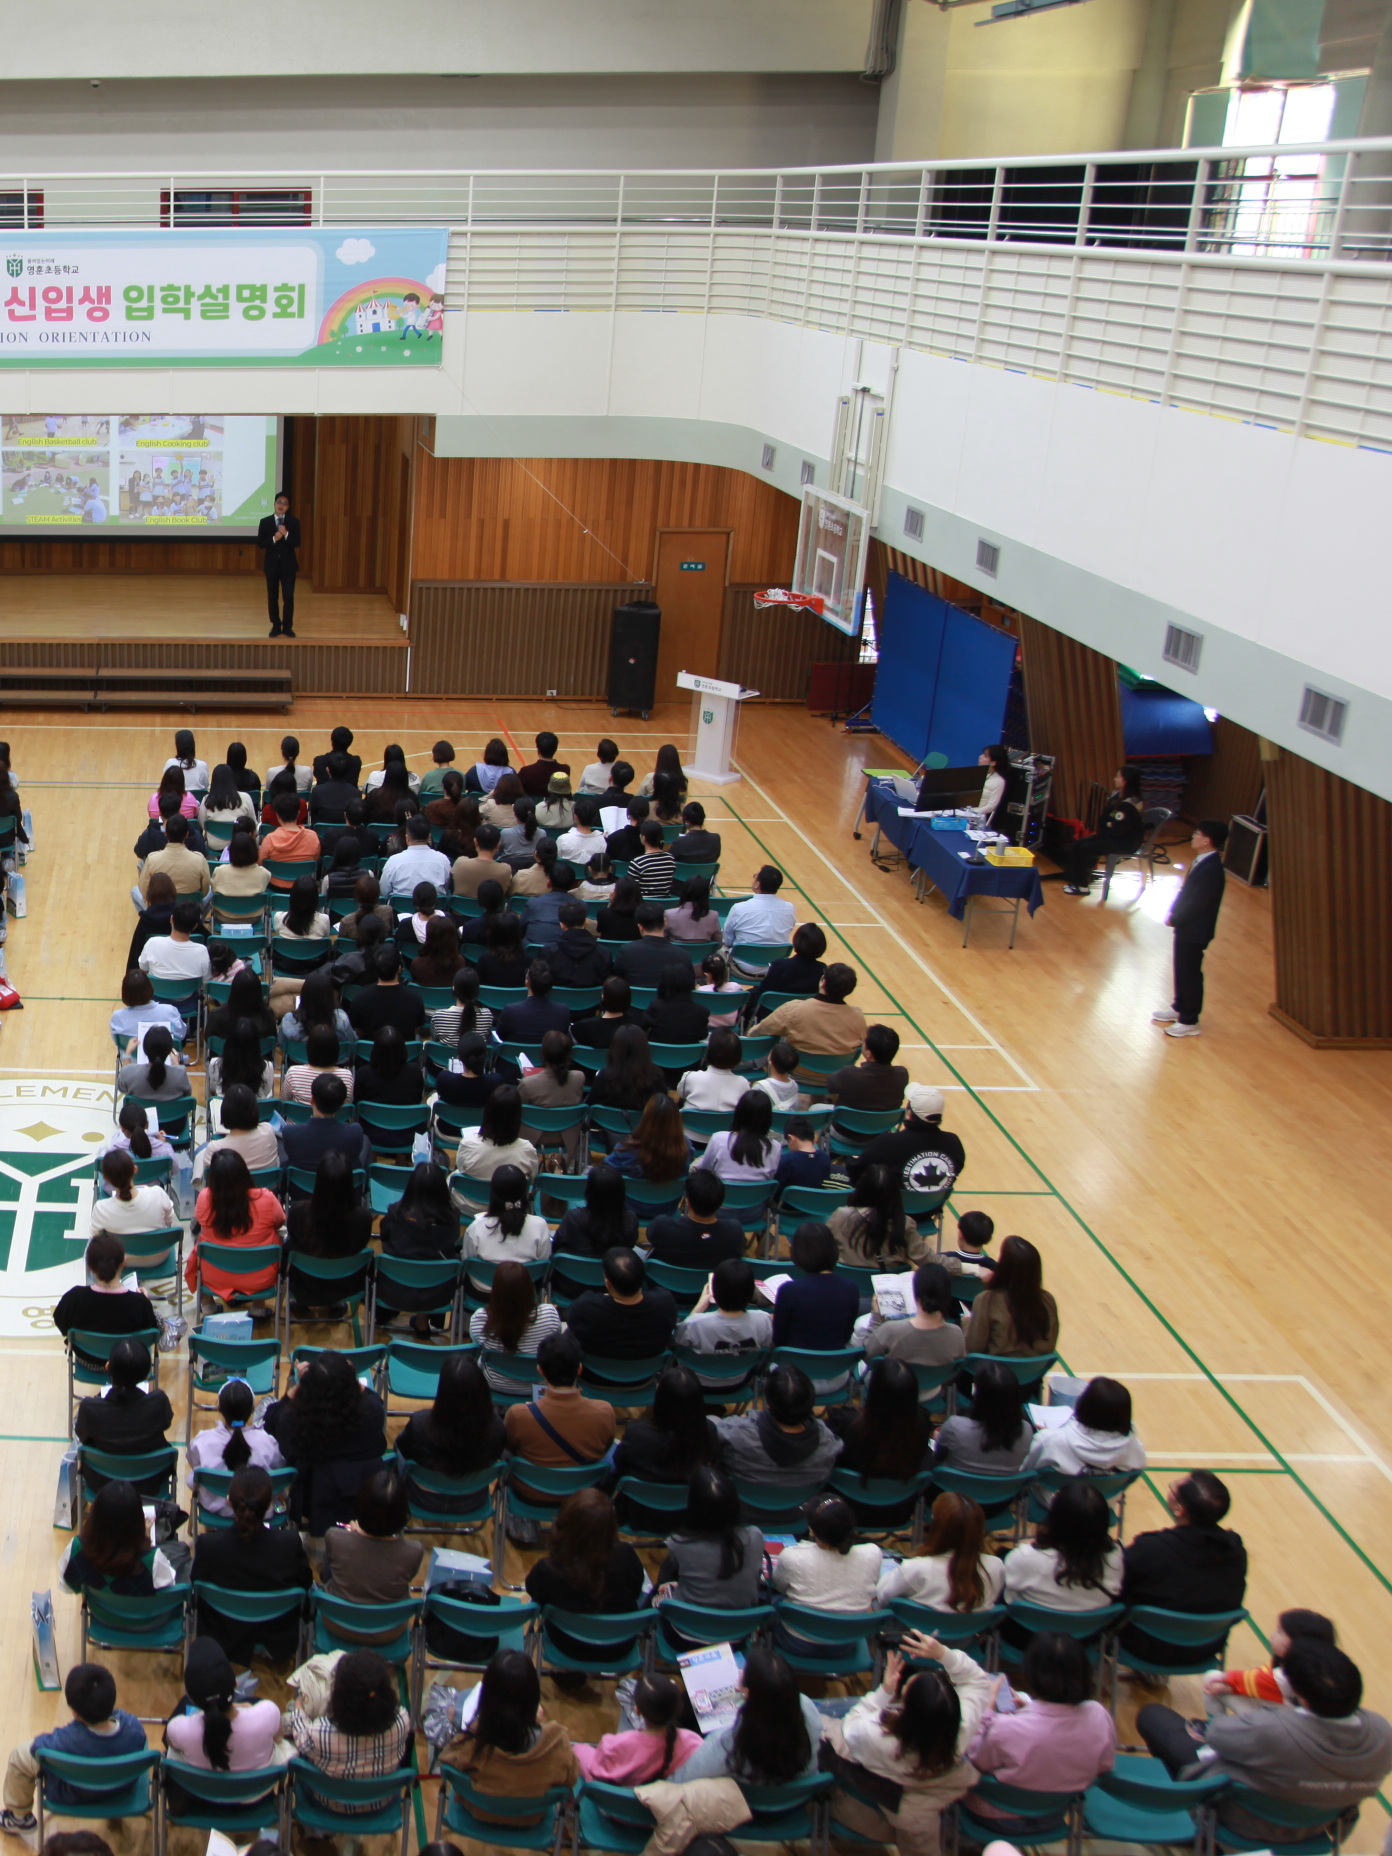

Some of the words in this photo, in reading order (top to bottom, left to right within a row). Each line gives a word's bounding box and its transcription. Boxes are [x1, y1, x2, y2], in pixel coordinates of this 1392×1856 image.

[26, 265, 80, 275] 영훈초등학교
[3, 285, 112, 323] 신입생
[122, 282, 306, 321] 입학설명회
[38, 330, 152, 343] ORIENTATION
[17, 438, 44, 447] English
[136, 440, 161, 448] English
[162, 440, 192, 448] Cooking
[145, 516, 171, 525] English
[171, 516, 190, 524] Book
[190, 516, 208, 524] Club
